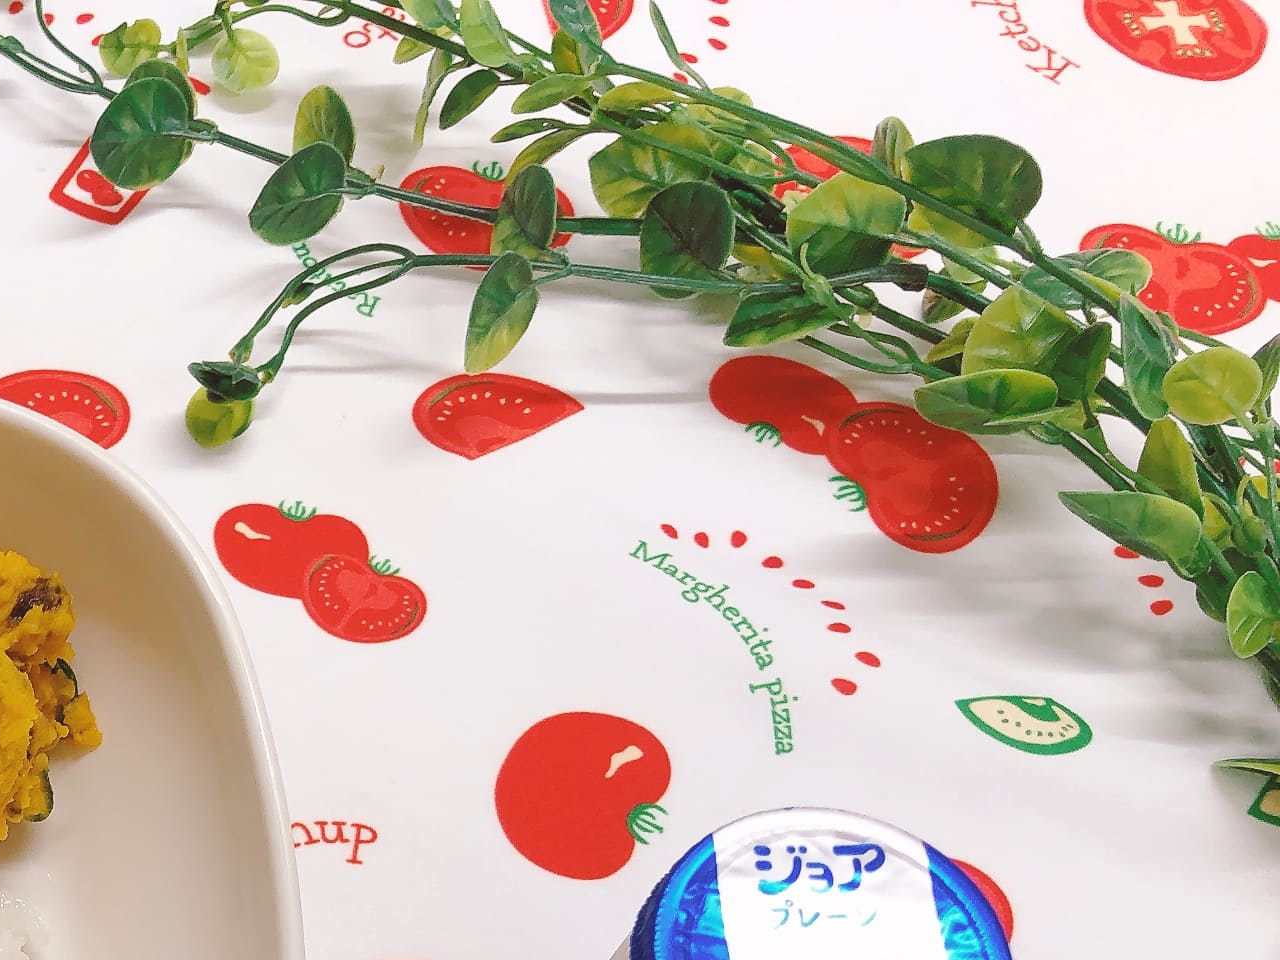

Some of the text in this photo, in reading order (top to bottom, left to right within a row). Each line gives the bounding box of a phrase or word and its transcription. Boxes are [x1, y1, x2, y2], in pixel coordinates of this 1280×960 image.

[628, 539, 799, 756] Margherita pizza
[753, 843, 886, 895] ジョア
